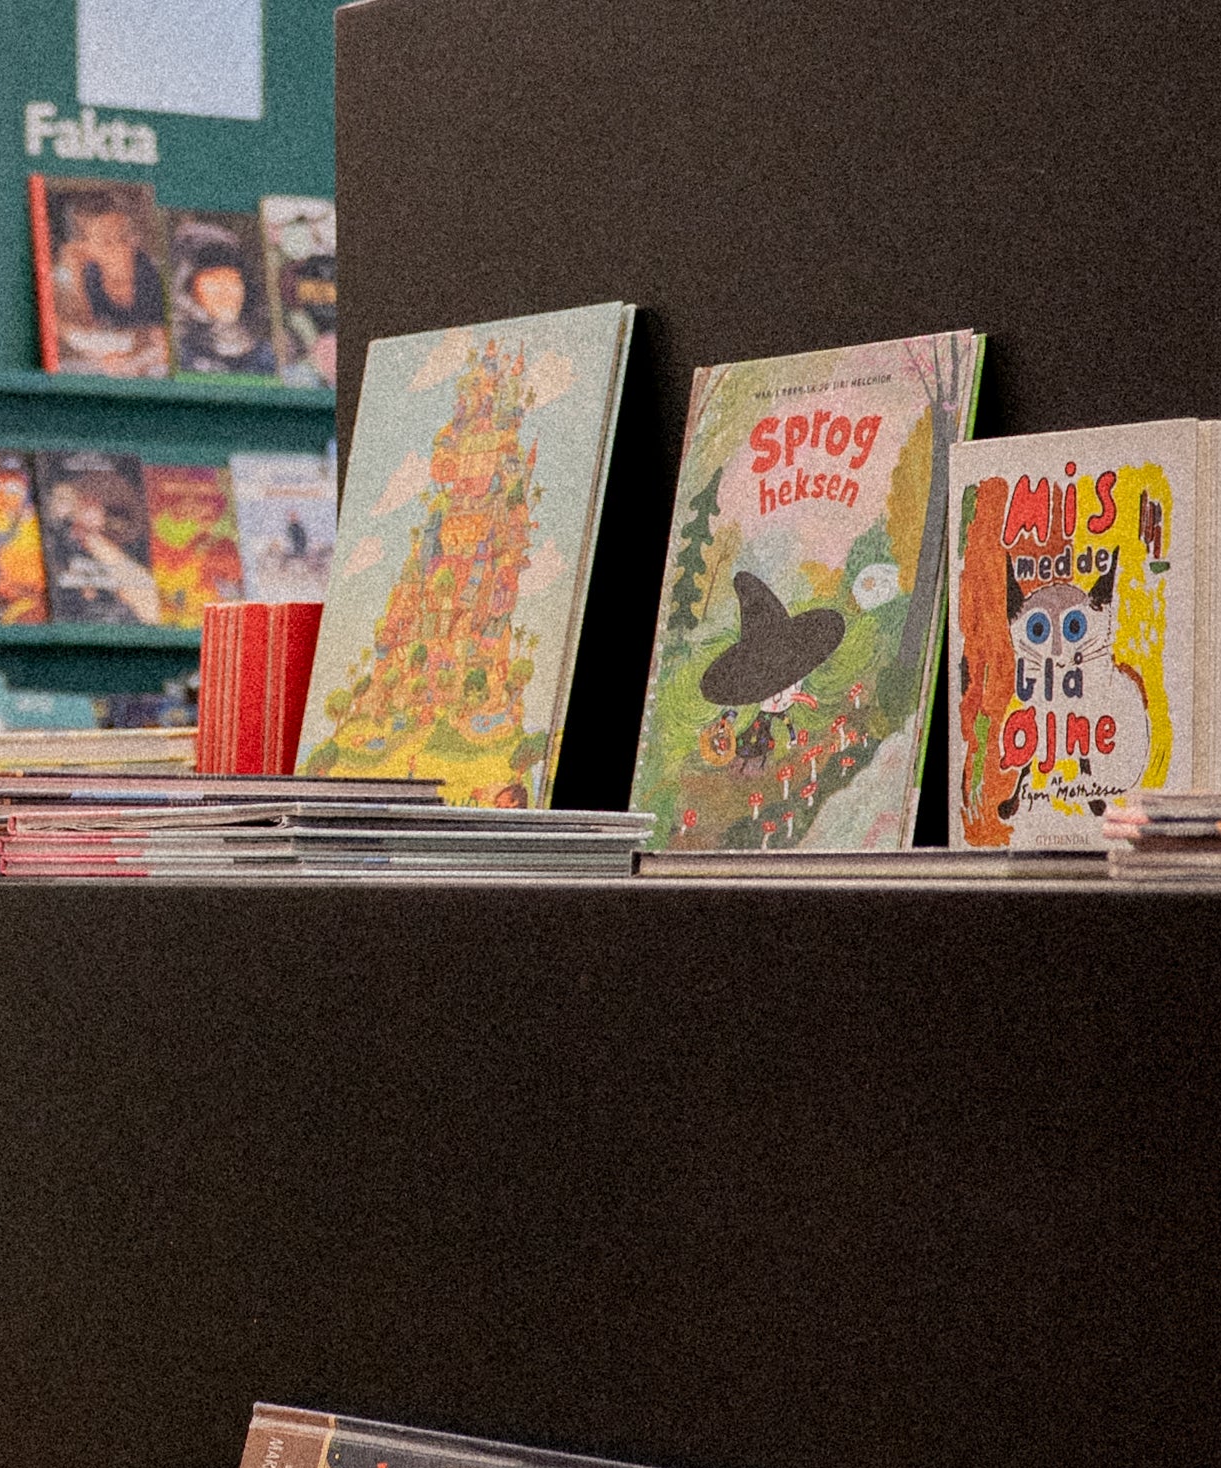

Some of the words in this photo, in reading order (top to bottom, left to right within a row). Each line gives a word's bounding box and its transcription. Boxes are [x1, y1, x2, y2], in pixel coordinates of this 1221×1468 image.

[25, 100, 159, 166] Fakta
[749, 409, 883, 474] Sprog
[759, 468, 860, 516] heksen
[1017, 547, 1072, 580] med
[1077, 546, 1110, 574] de
[1016, 651, 1083, 702] blå
[1021, 783, 1050, 812] Egon
[1056, 782, 1127, 802] Mathiesen
